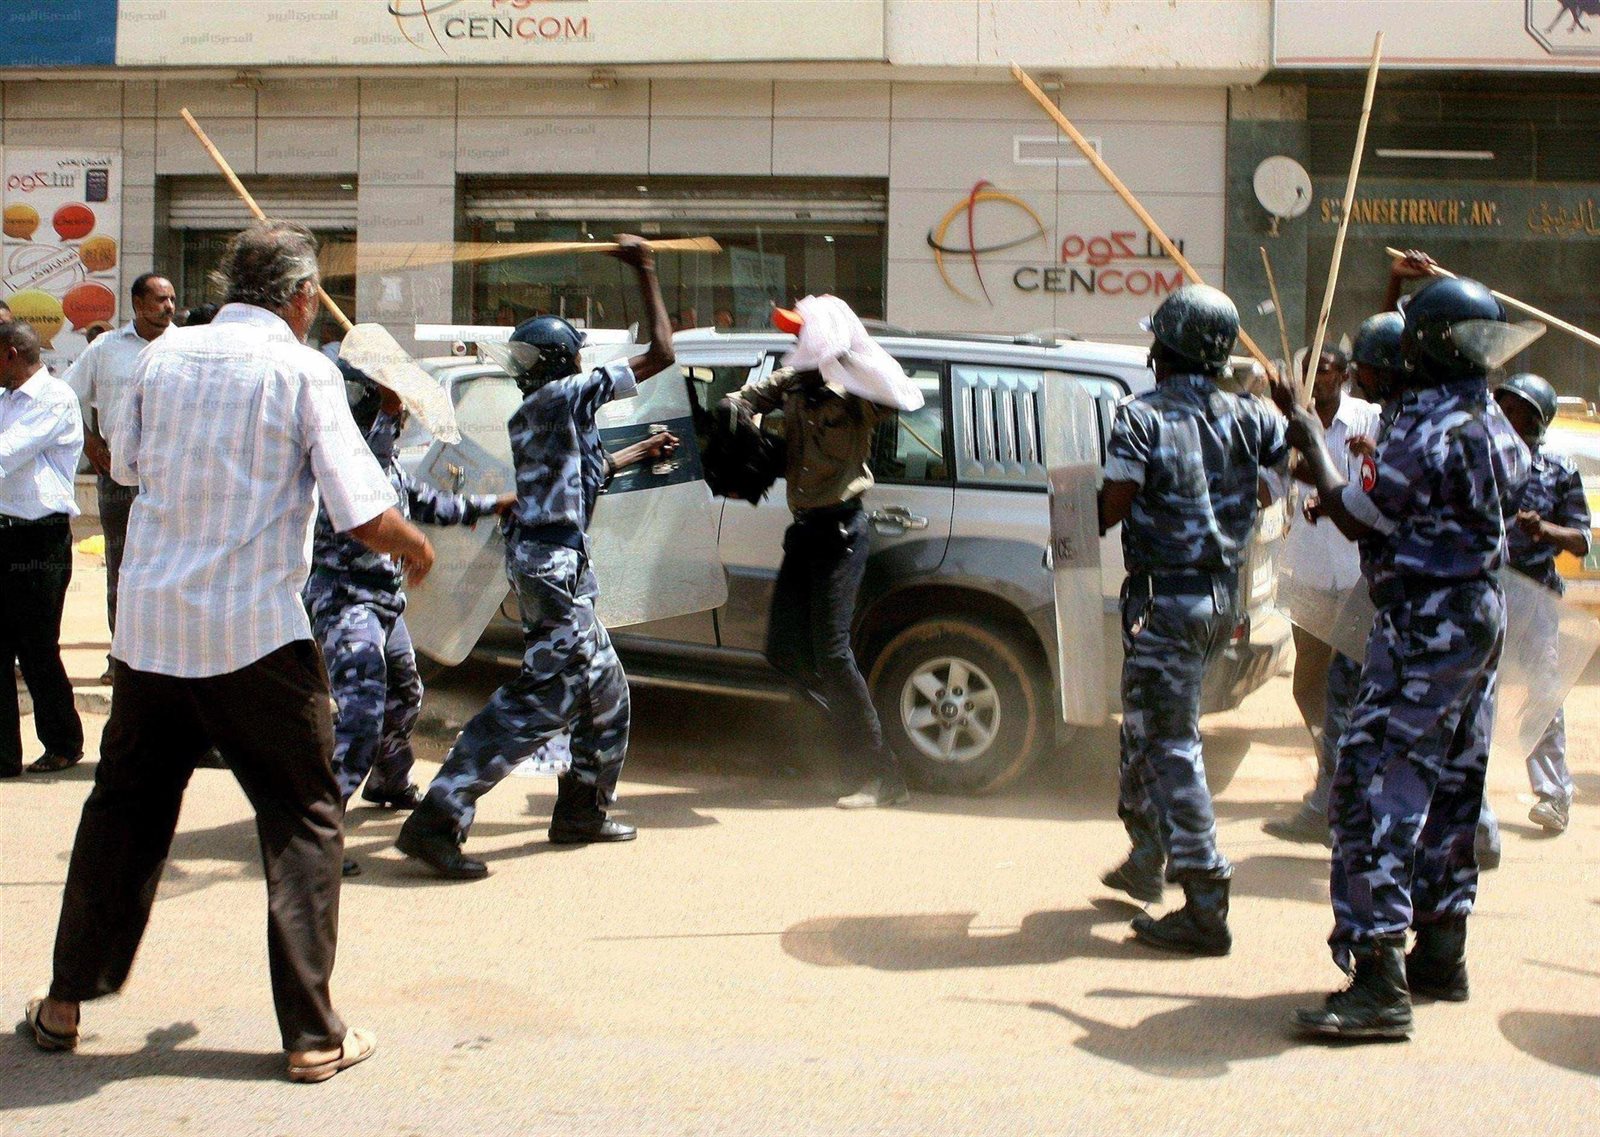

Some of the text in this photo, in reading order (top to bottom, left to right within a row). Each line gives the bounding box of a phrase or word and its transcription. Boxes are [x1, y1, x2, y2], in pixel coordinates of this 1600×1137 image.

[445, 16, 589, 40] CENCOM
[1401, 198, 1458, 225] FRENCH
[1013, 267, 1183, 296] CENCOM
